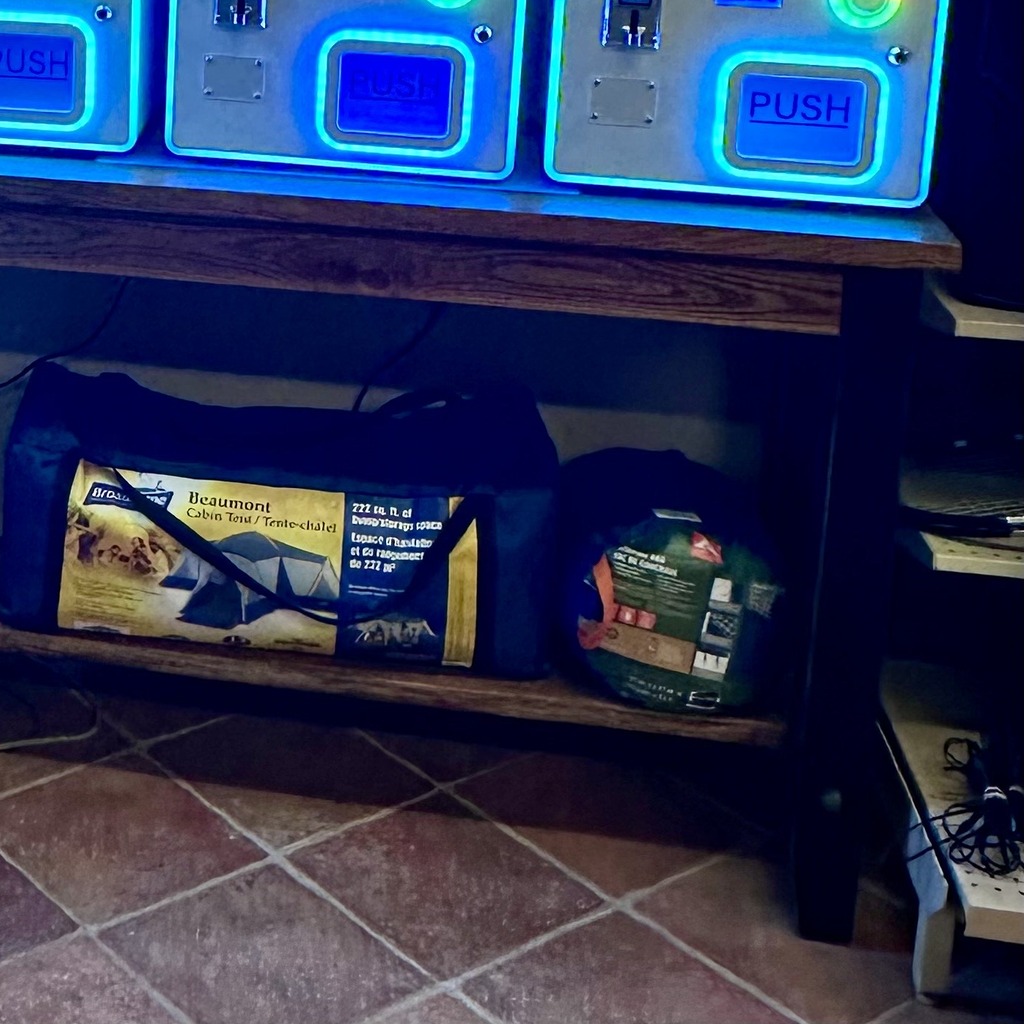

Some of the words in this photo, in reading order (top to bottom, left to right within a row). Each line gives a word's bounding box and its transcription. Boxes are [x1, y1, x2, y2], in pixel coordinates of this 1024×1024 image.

[349, 69, 440, 100] PUSH
[749, 91, 851, 124] PUSH
[189, 491, 271, 513] Beaumont
[352, 503, 372, 513] 222
[187, 507, 222, 521] Cabin
